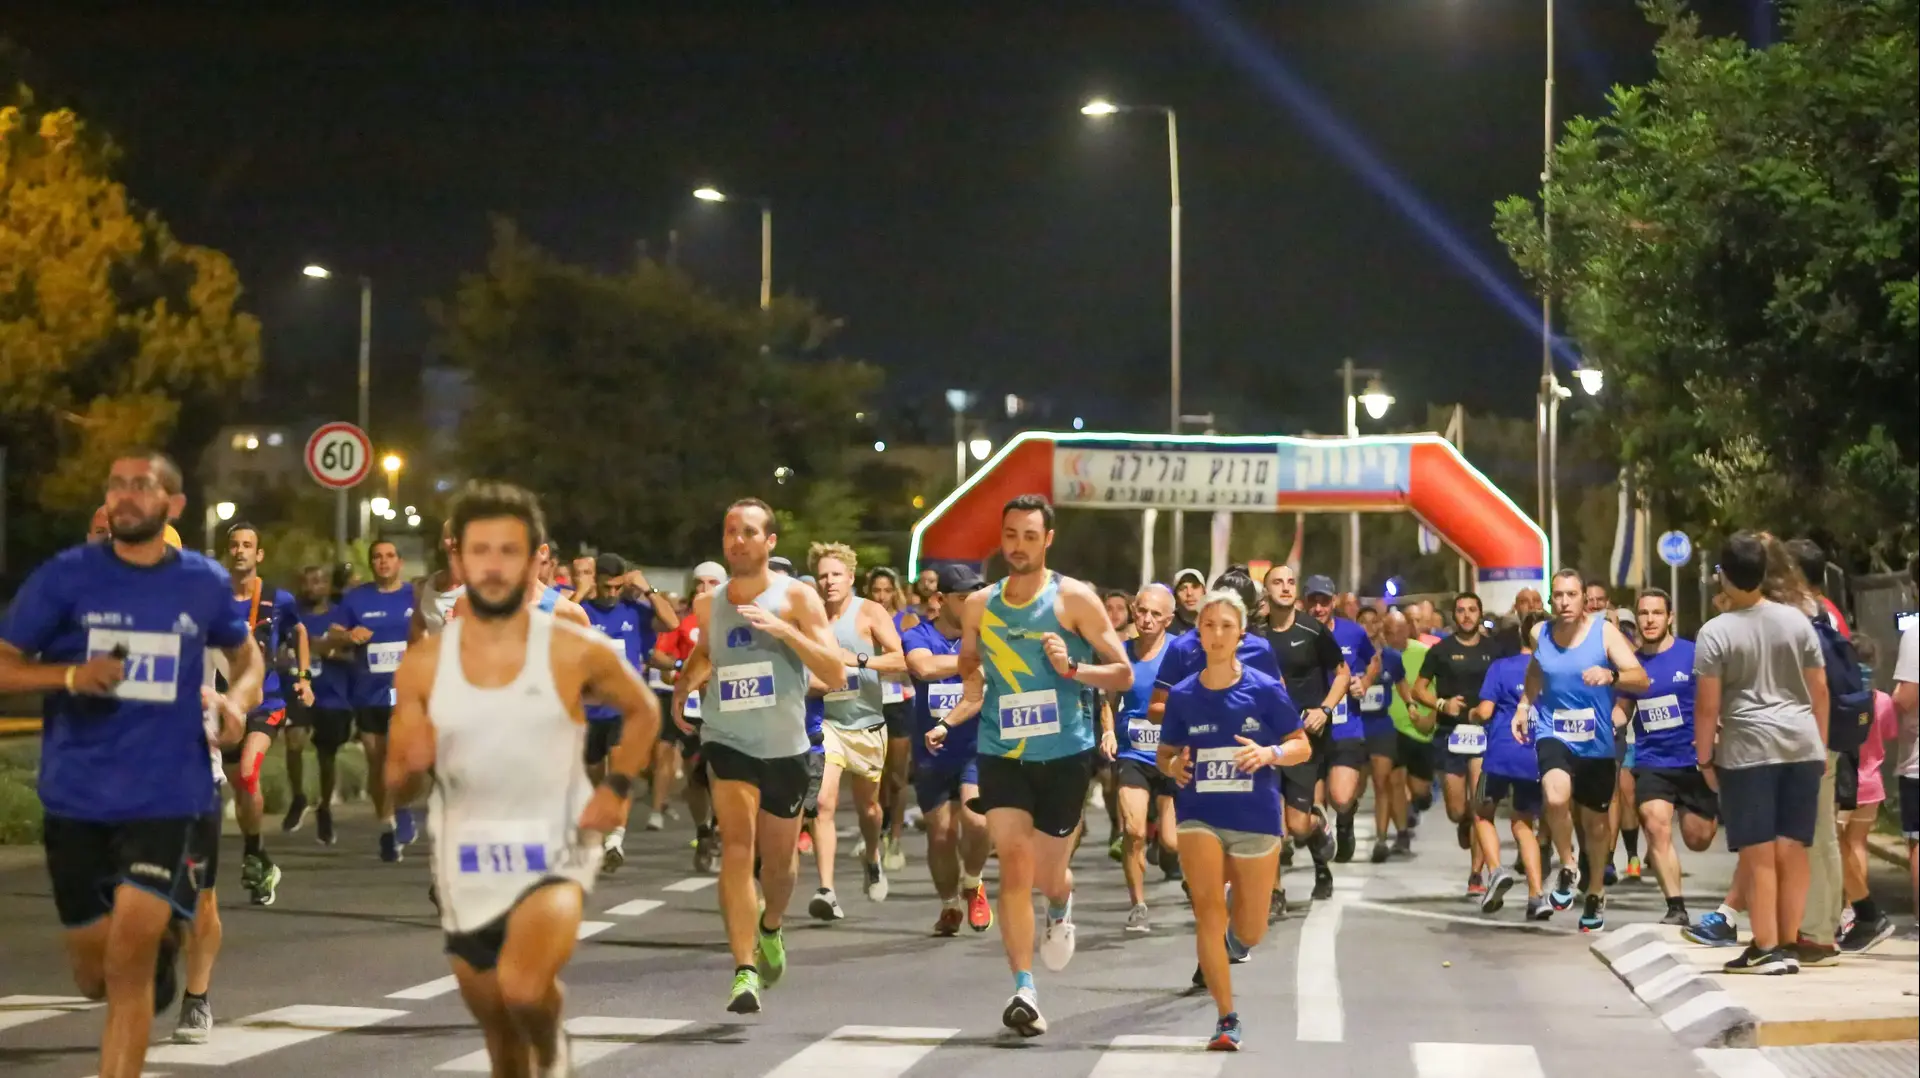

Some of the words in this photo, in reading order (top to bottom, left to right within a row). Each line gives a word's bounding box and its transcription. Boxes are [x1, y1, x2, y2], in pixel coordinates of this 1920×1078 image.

[322, 440, 355, 472] 60
[1110, 453, 1187, 482] הלילה
[1209, 458, 1269, 485] מרוץ
[127, 655, 156, 682] 71
[729, 678, 760, 699] 782
[1012, 706, 1042, 726] 871
[1648, 707, 1671, 721] 693
[1562, 720, 1586, 733] 442
[1207, 761, 1237, 779] 847
